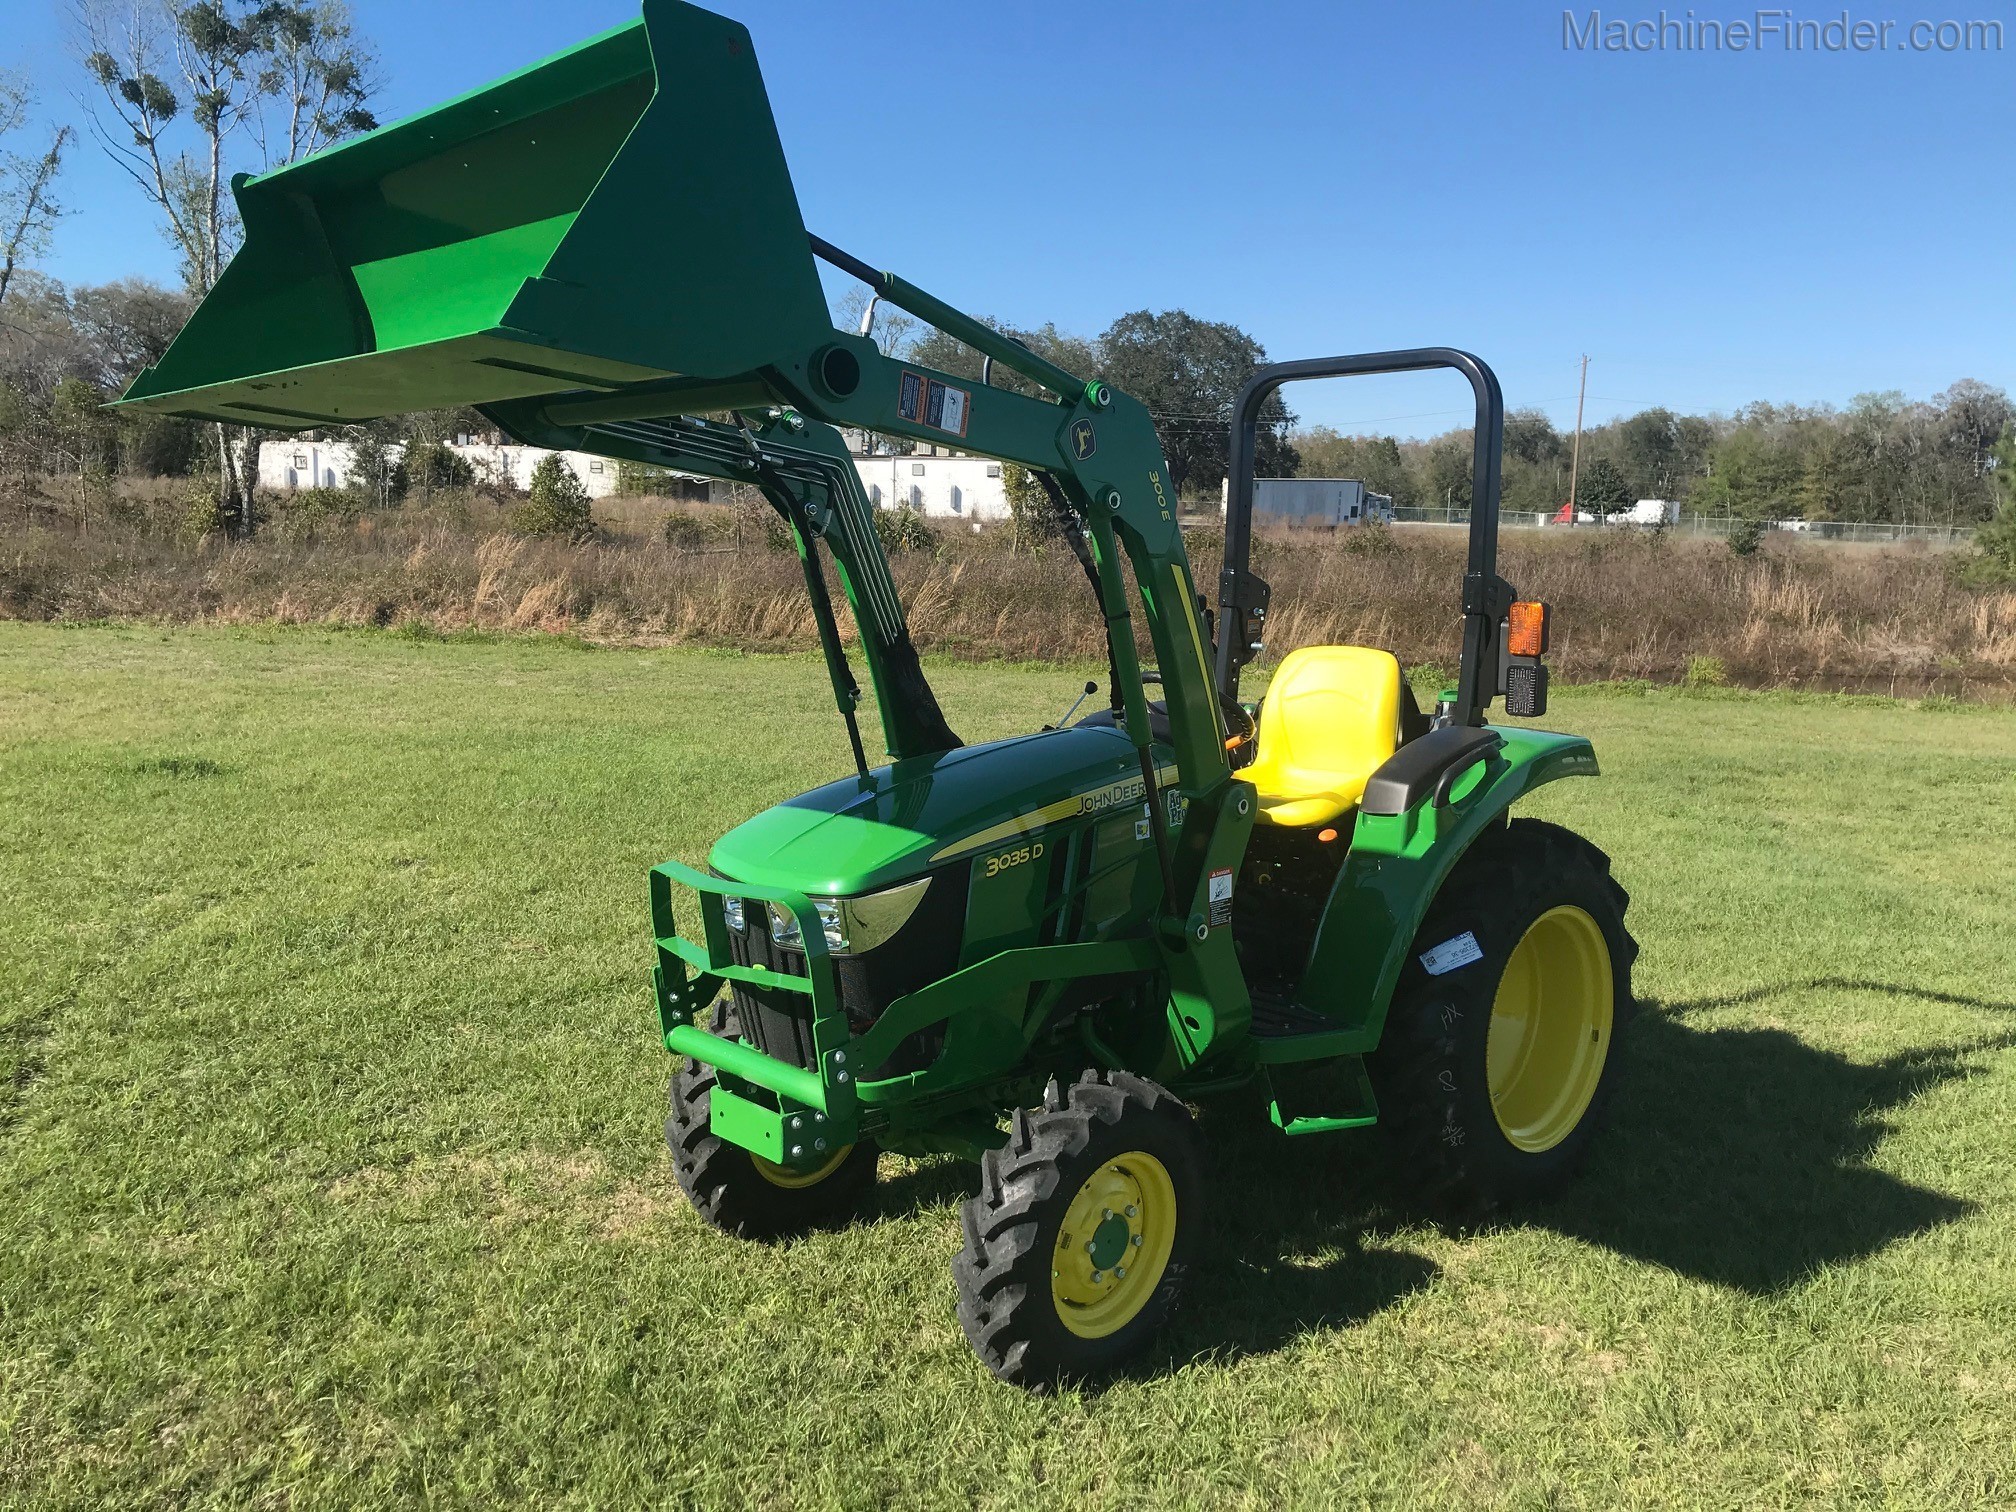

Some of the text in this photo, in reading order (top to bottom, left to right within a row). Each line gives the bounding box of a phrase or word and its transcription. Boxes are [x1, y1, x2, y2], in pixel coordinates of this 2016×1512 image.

[1077, 782, 1147, 814] JOHN DEER
[986, 847, 1030, 877] 3035
